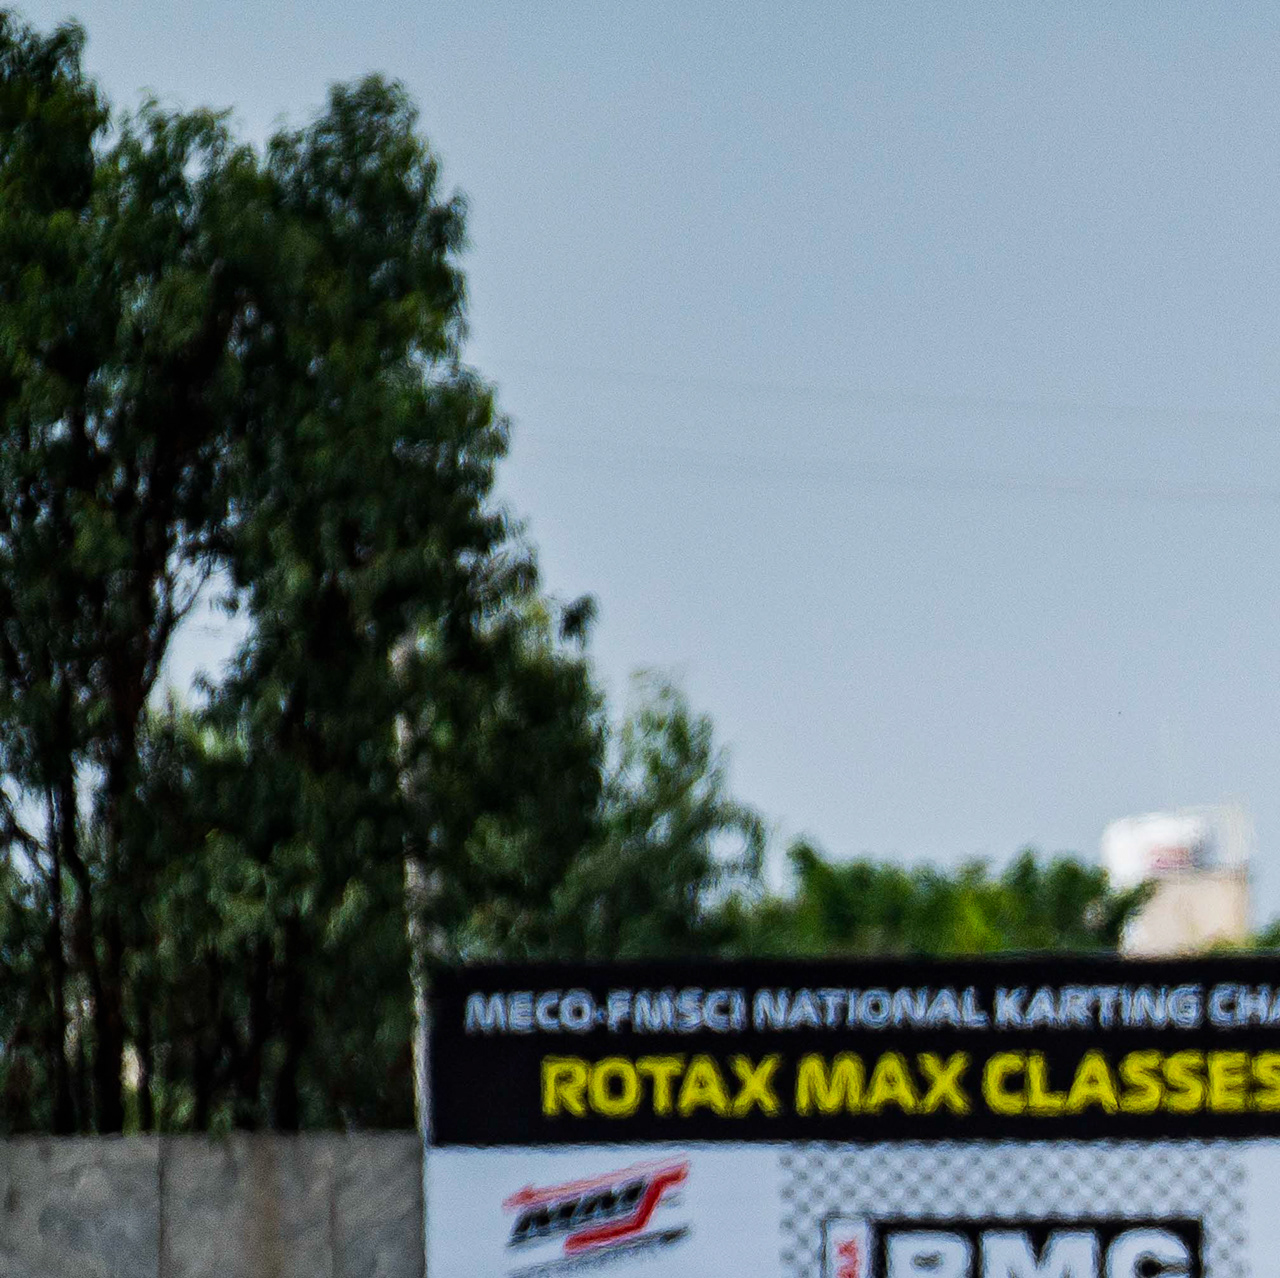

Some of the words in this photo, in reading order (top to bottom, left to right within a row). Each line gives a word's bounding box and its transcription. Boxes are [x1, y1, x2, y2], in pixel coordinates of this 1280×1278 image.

[753, 984, 987, 1031] NATIONAL
[994, 982, 1199, 1030] KARTING
[541, 1053, 781, 1118] ROTAX
[796, 1051, 971, 1117] MAX
